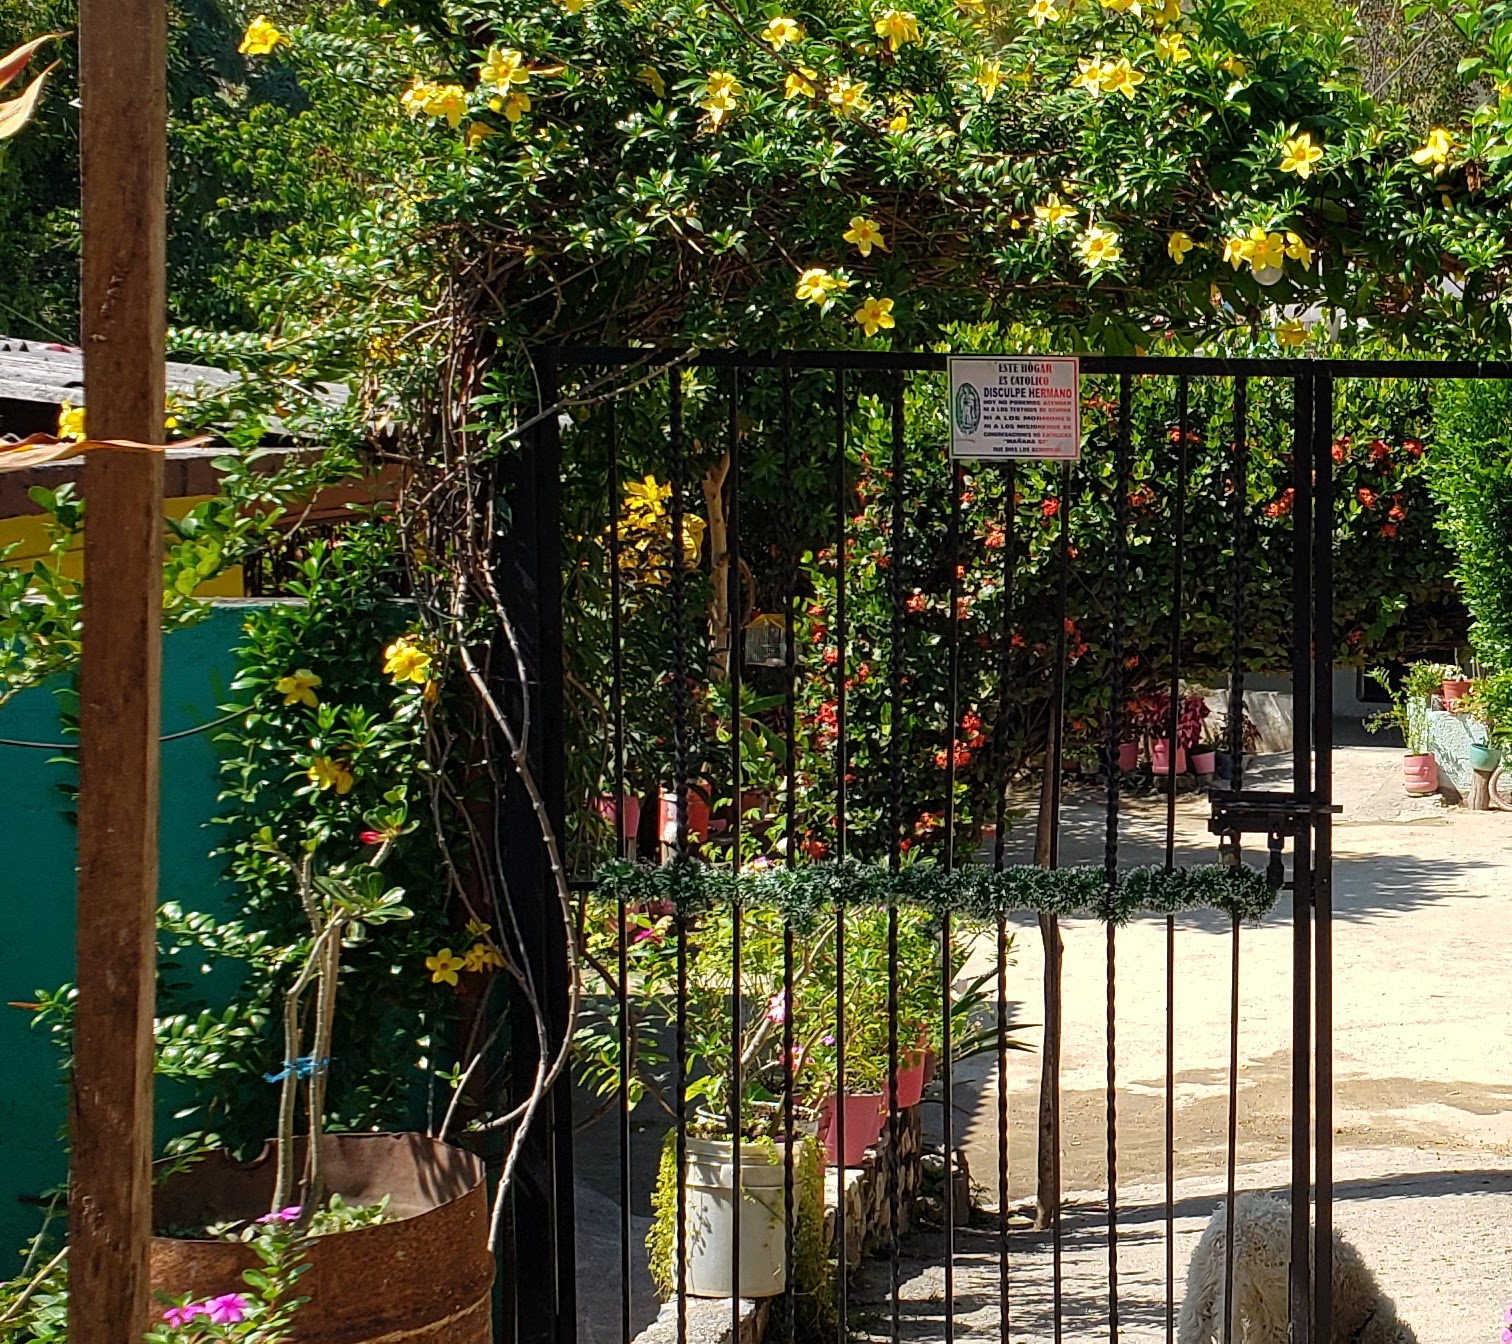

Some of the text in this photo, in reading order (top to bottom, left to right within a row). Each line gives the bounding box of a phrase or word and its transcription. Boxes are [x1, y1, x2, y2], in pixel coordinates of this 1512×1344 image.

[999, 364, 1019, 373] ESTE
[999, 376, 1049, 386] ES CATOLICO
[984, 387, 1072, 399] DISCULPE HERMANO
